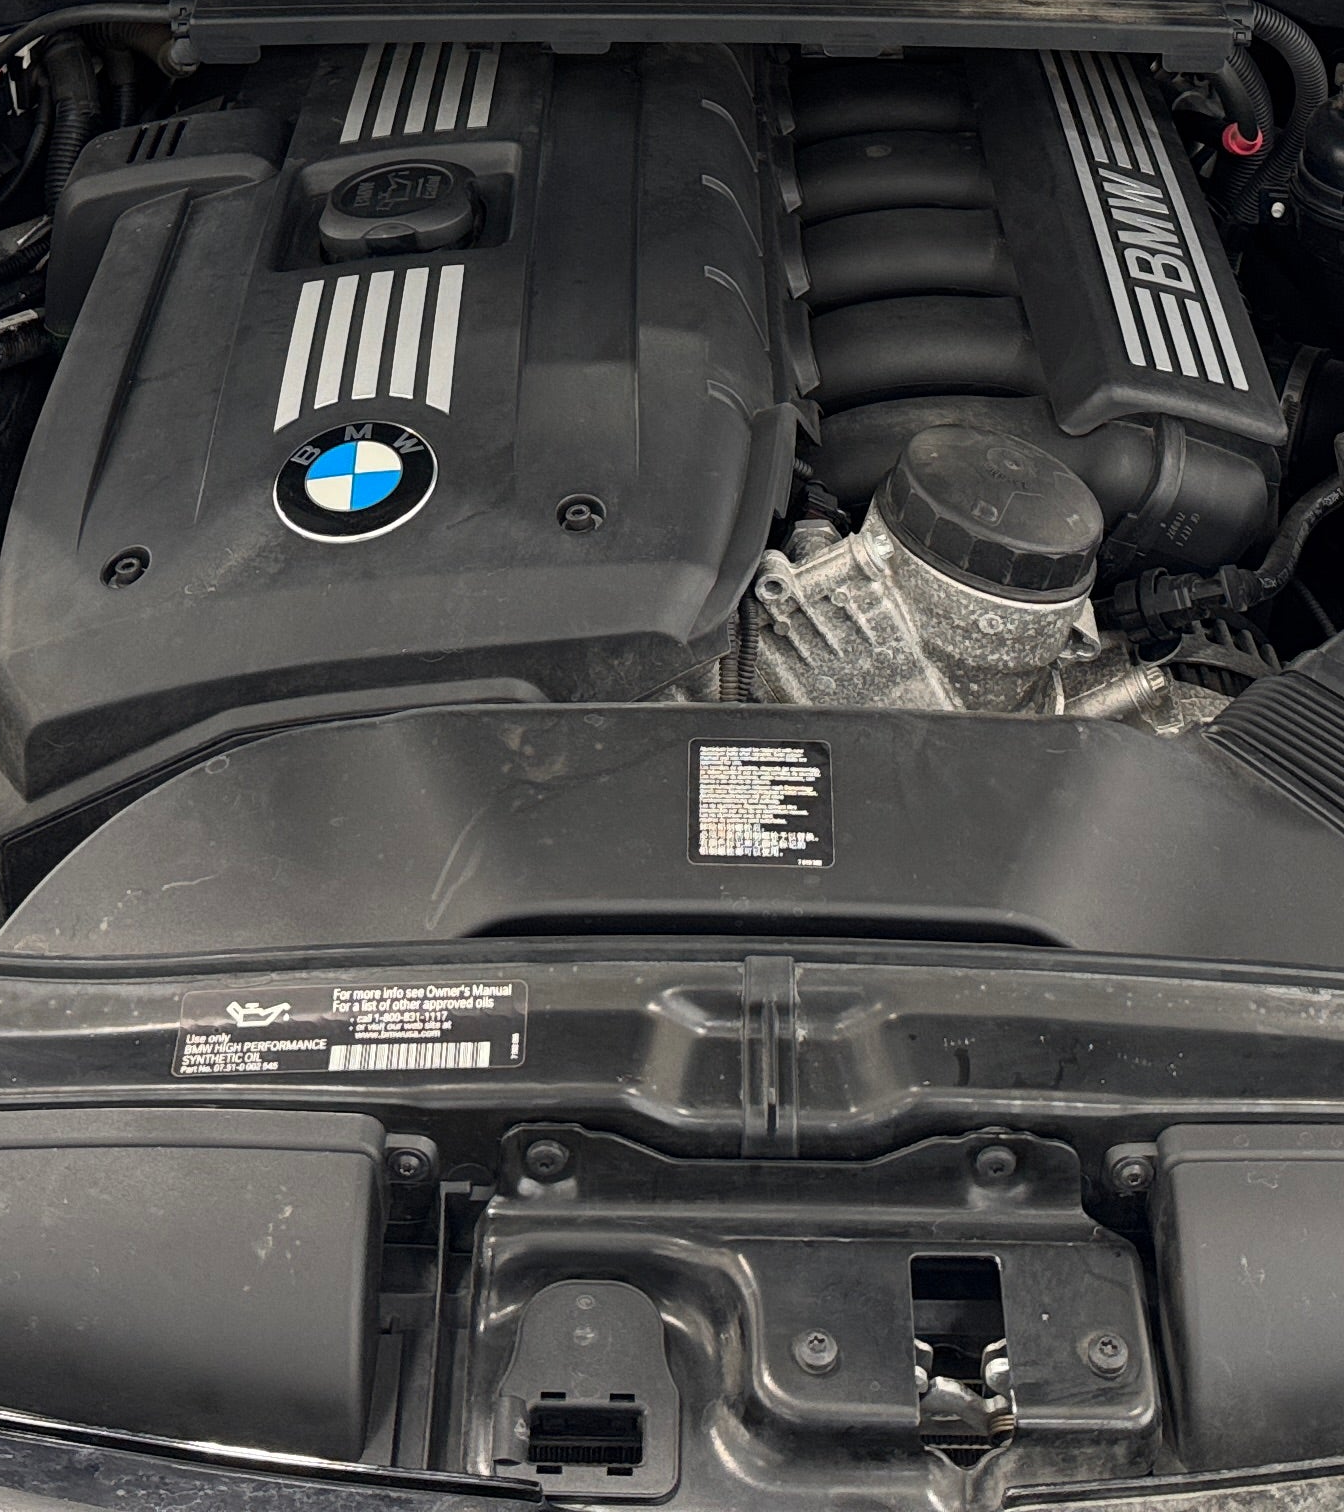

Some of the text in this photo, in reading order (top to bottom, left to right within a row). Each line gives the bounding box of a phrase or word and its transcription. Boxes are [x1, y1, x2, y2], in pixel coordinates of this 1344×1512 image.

[1098, 167, 1196, 294] BMW
[290, 422, 424, 466] BMW
[333, 989, 352, 1001] For
[353, 988, 382, 1000] more
[405, 989, 425, 999] see
[425, 985, 471, 998] Owner's
[472, 984, 513, 997] Manual
[332, 1000, 352, 1013] For
[352, 1002, 360, 1012] a
[360, 999, 378, 1011] list
[378, 999, 391, 1011] of
[392, 998, 422, 1010] other
[422, 997, 474, 1011] approved
[356, 1011, 373, 1023] call
[386, 1022, 404, 1031] our
[403, 1021, 424, 1031] web
[424, 1020, 442, 1031] site
[442, 1019, 453, 1030] at
[184, 1038, 328, 1055] BMW HIGH PERFORMANCE
[185, 1032, 232, 1046] Use only
[181, 1052, 263, 1066] SYNTHETIC OIL
[180, 1064, 197, 1074] Part
[197, 1063, 213, 1073] No.
